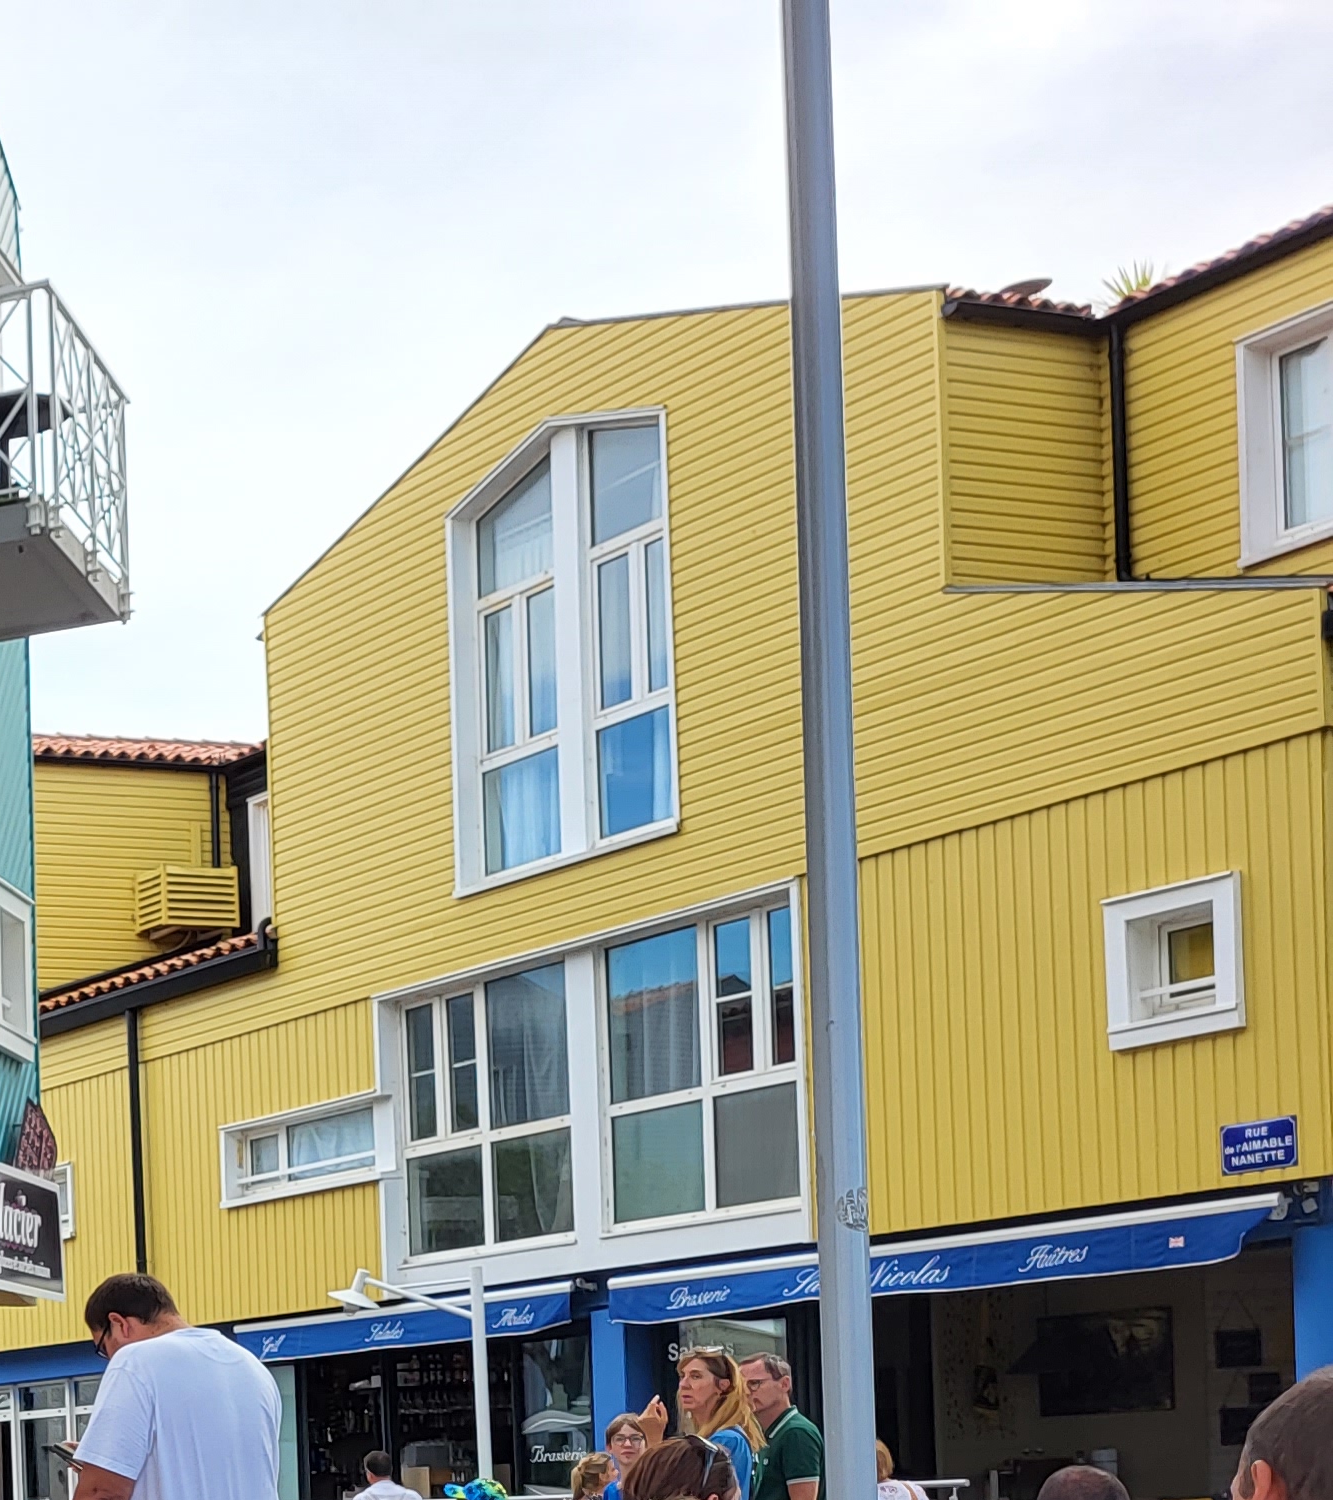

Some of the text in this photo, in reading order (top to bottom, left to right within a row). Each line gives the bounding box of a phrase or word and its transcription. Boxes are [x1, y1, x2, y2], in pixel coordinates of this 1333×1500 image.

[1245, 1126, 1268, 1139] RUE
[1225, 1135, 1293, 1155] de l'AIMABLE
[1231, 1149, 1286, 1167] NANETTE
[1019, 1243, 1089, 1272] Huîtres
[868, 1254, 952, 1288] Nicolas
[666, 1284, 731, 1311] Brasserie
